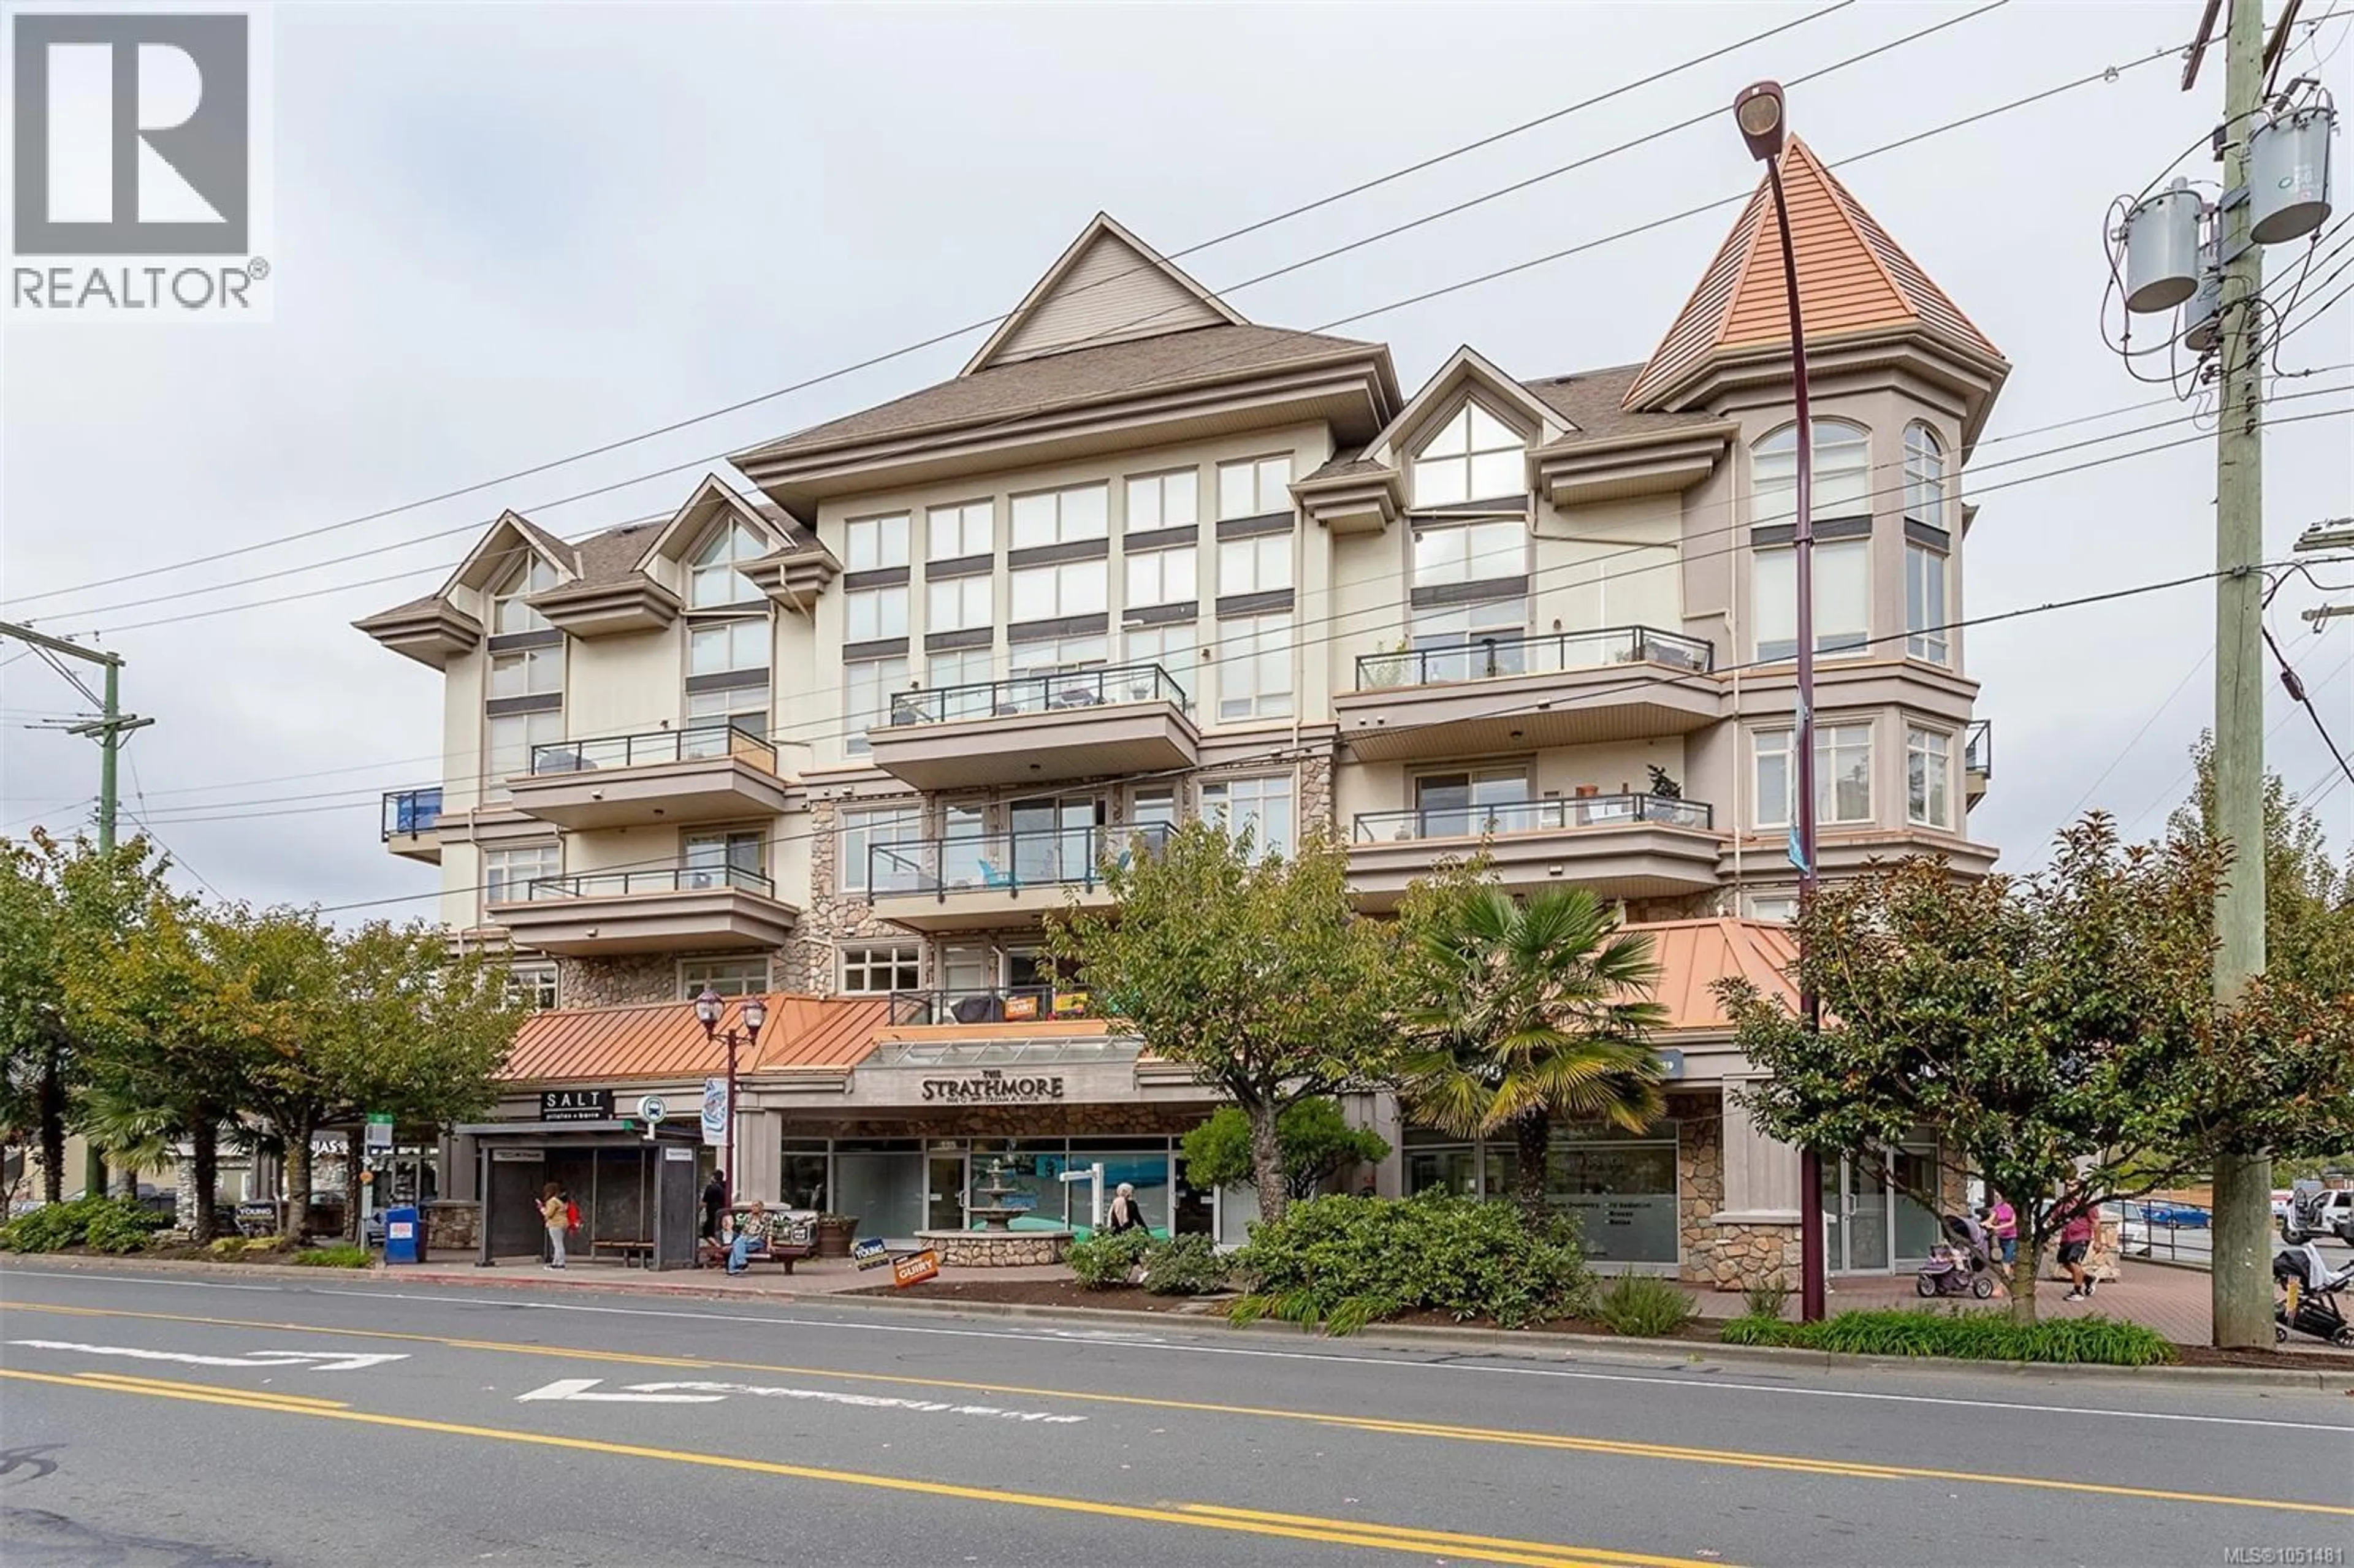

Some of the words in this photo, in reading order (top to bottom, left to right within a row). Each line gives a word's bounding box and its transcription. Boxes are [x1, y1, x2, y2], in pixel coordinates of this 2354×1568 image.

[922, 1077, 1064, 1100] STRATHMORE
[547, 1092, 600, 1107] SALT
[855, 1244, 884, 1259] YOUNG
[899, 1259, 932, 1279] GUIRY
